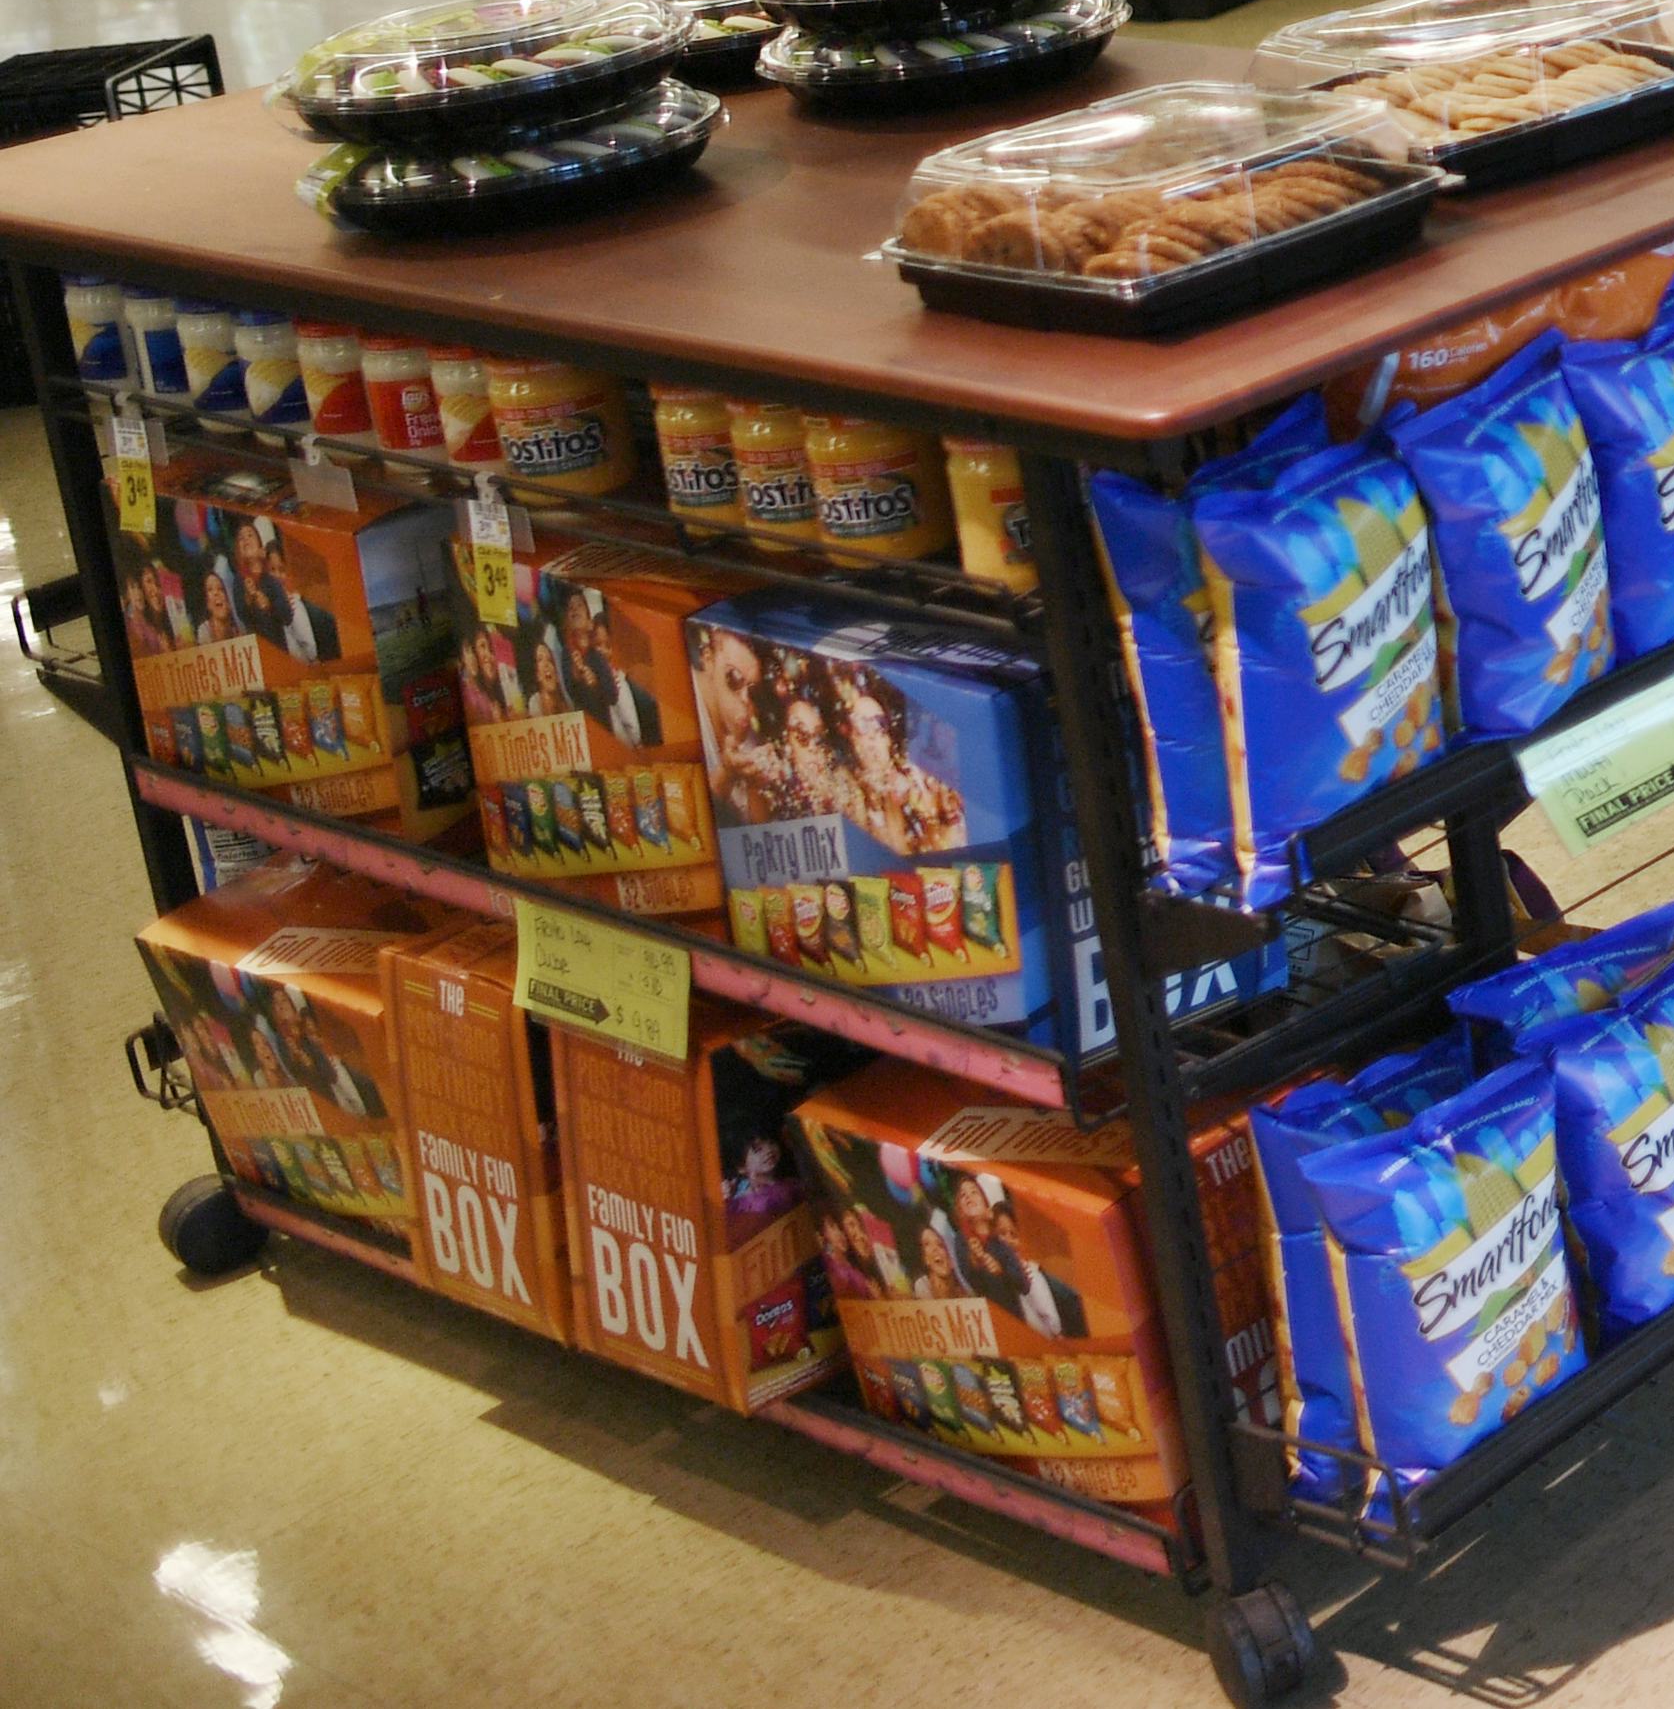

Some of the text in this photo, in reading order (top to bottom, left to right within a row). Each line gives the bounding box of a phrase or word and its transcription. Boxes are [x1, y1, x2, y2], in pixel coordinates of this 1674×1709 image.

[1407, 348, 1449, 370] 160
[126, 474, 149, 506] 349
[483, 563, 509, 597] 349
[1581, 792, 1630, 832] FINAL
[424, 1170, 533, 1306] BOX
[1413, 1193, 1558, 1335] Smartfoo
[591, 1225, 711, 1370] BOX
[1476, 1280, 1561, 1367] CHEDDAR MIX
[1482, 1287, 1543, 1344] CARAMEL
